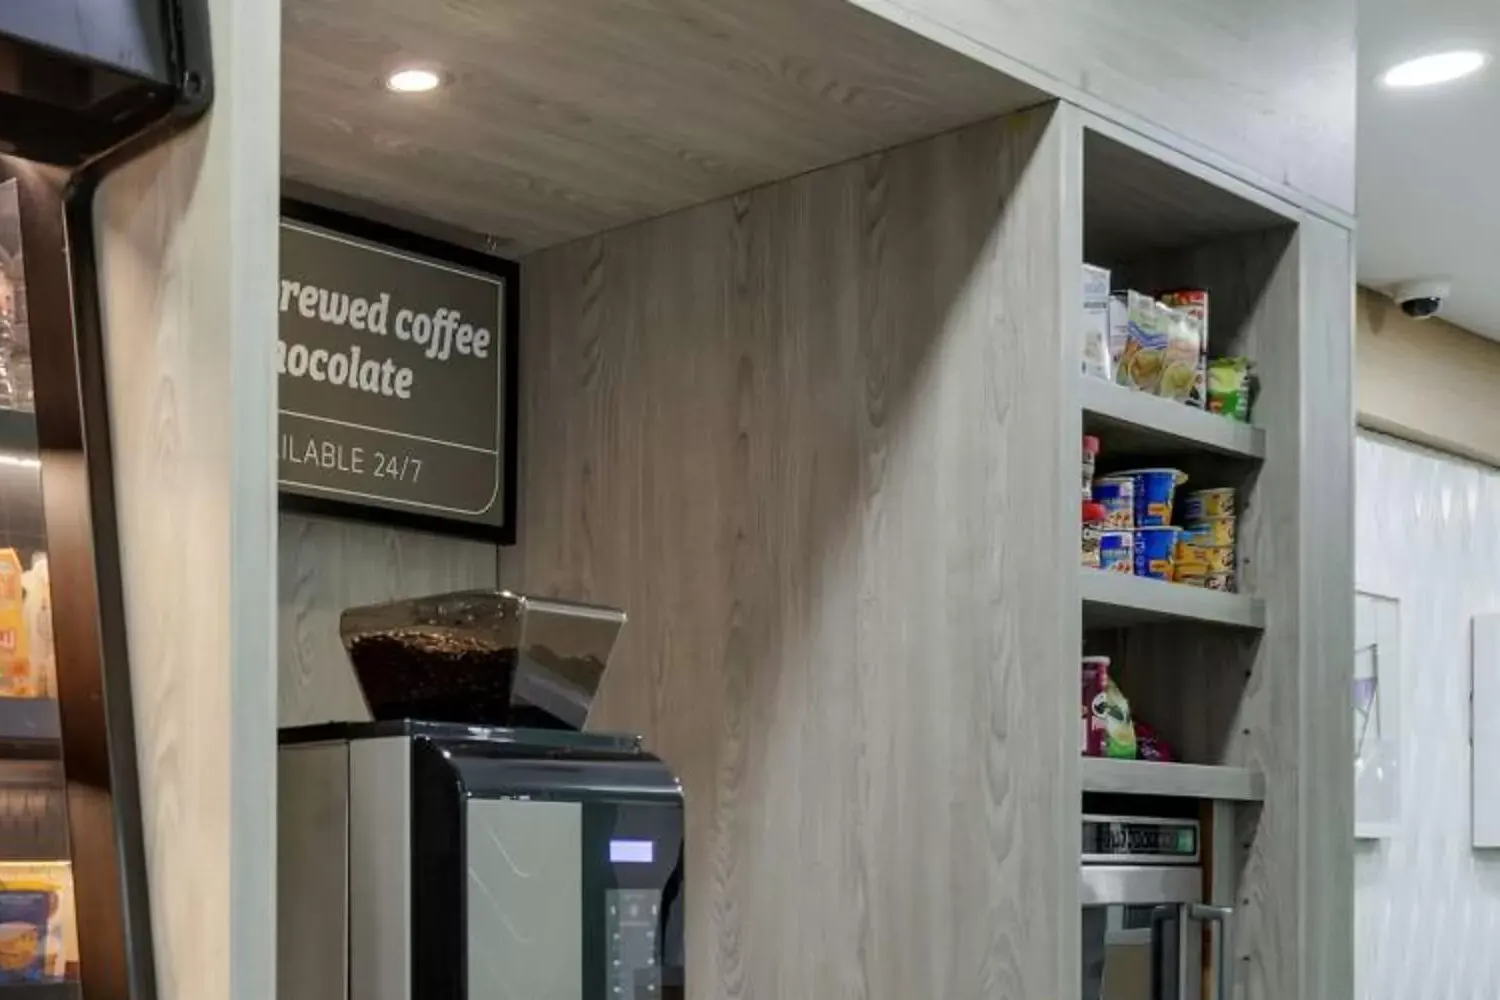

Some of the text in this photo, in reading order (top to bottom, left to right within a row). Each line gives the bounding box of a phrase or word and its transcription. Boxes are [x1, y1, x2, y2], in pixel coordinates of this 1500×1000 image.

[280, 279, 490, 360] rewed coffee
[278, 340, 414, 399] ocolate
[282, 434, 423, 484] ILABLE 24/7
